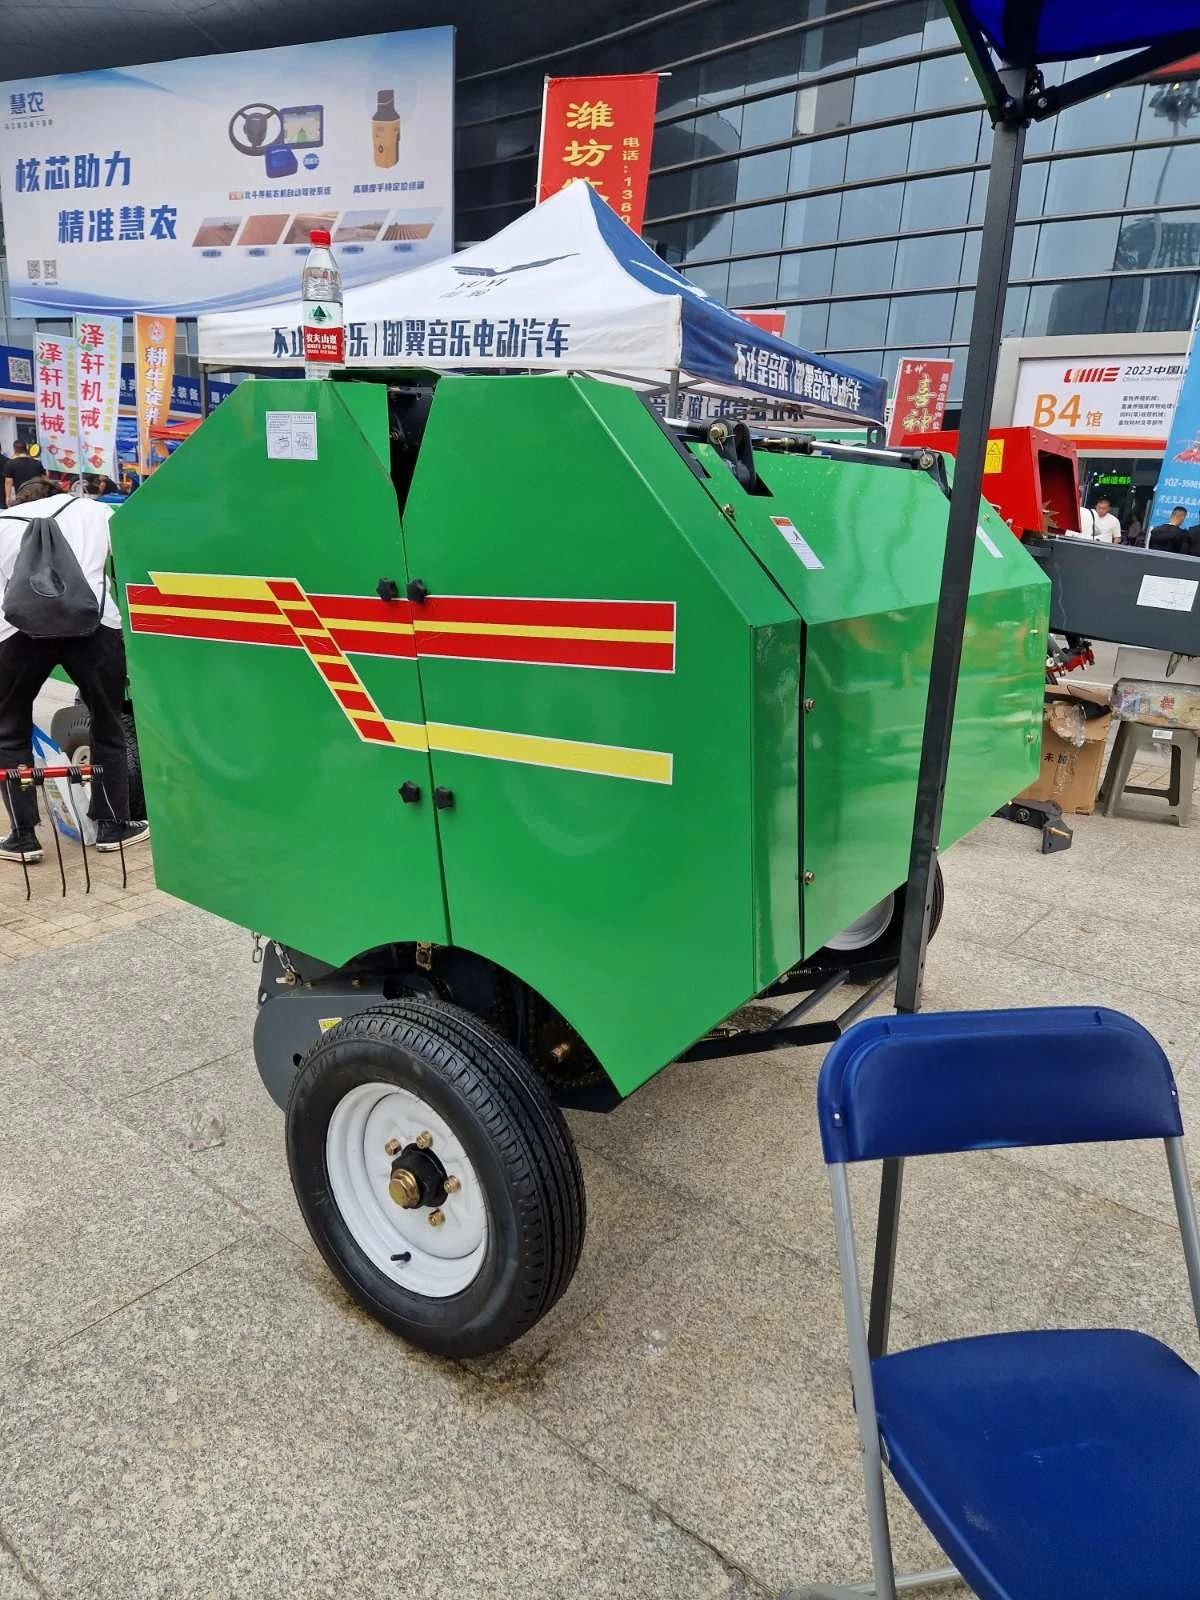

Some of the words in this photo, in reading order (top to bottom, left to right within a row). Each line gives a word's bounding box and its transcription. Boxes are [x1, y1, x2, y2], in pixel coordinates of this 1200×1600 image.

[15, 150, 131, 193] 核芯助力
[58, 204, 178, 244] 精准慧农
[306, 333, 338, 345] 农夫山泉
[39, 342, 66, 434] 泽轩机械
[1124, 365, 1187, 376] 2023中国
